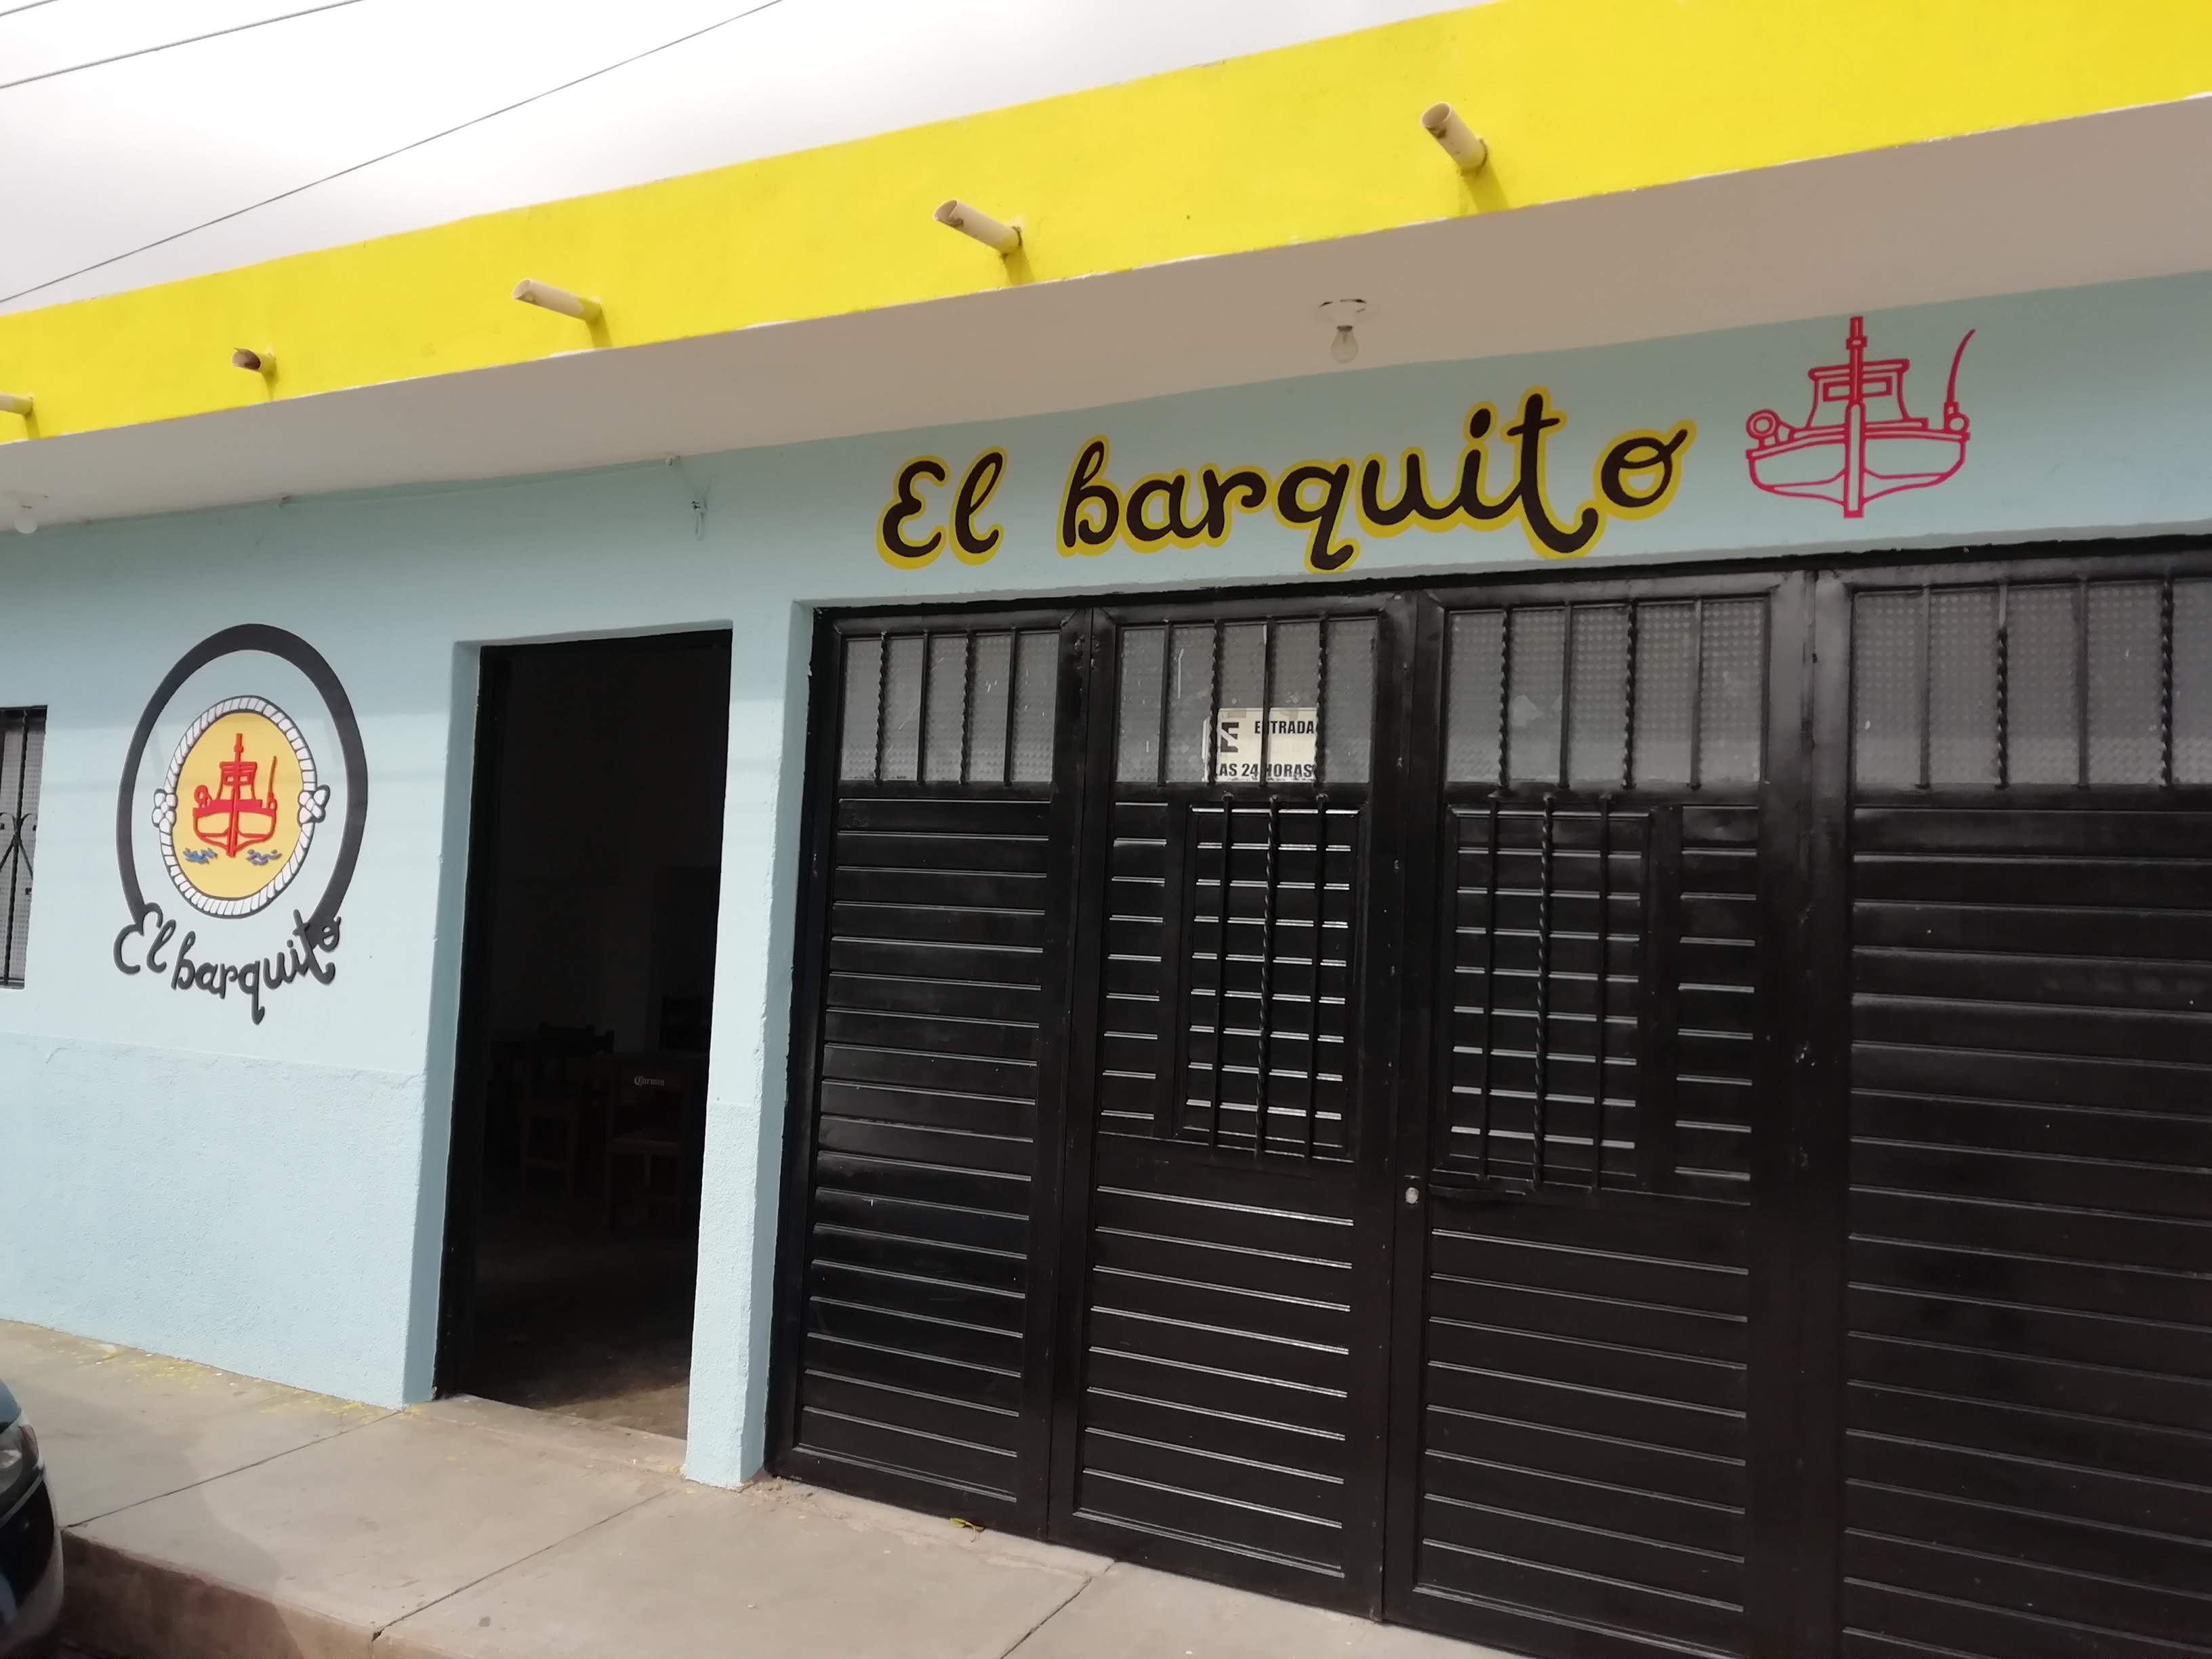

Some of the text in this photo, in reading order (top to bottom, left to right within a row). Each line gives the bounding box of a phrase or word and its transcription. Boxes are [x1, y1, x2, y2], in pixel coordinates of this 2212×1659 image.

[880, 391, 1689, 573] El barquito
[1254, 720, 1314, 734] ETRADA
[1215, 763, 1237, 777] AS
[1241, 763, 1259, 777] 24
[113, 903, 342, 1025] El barquito
